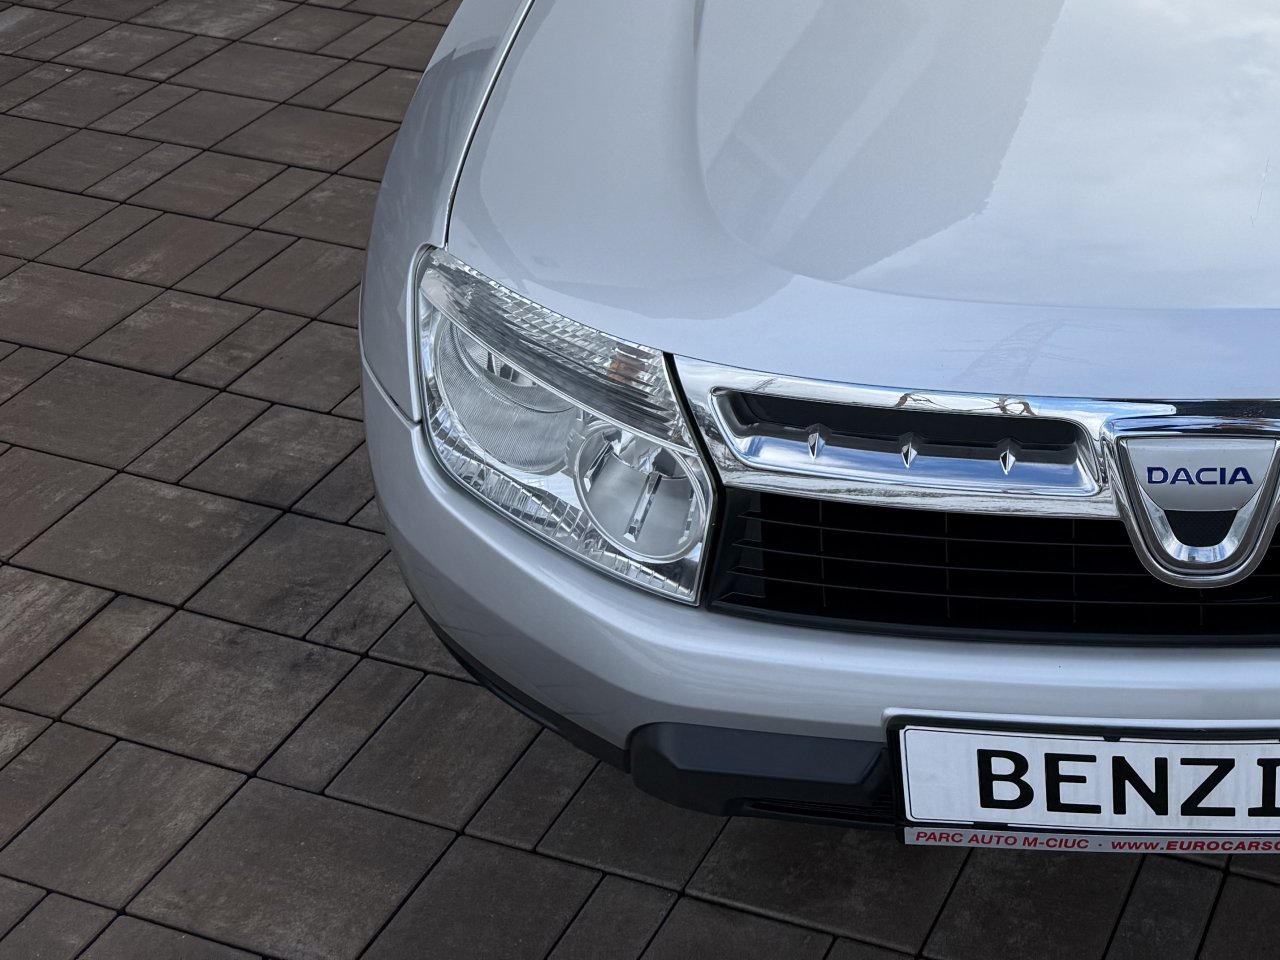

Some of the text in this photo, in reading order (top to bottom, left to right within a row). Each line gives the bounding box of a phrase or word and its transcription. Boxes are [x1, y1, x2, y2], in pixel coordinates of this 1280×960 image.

[1146, 466, 1254, 485] DACIA
[915, 831, 964, 844] PARC
[968, 833, 1018, 846] AUTO
[1022, 836, 1090, 850] M-CIUC
